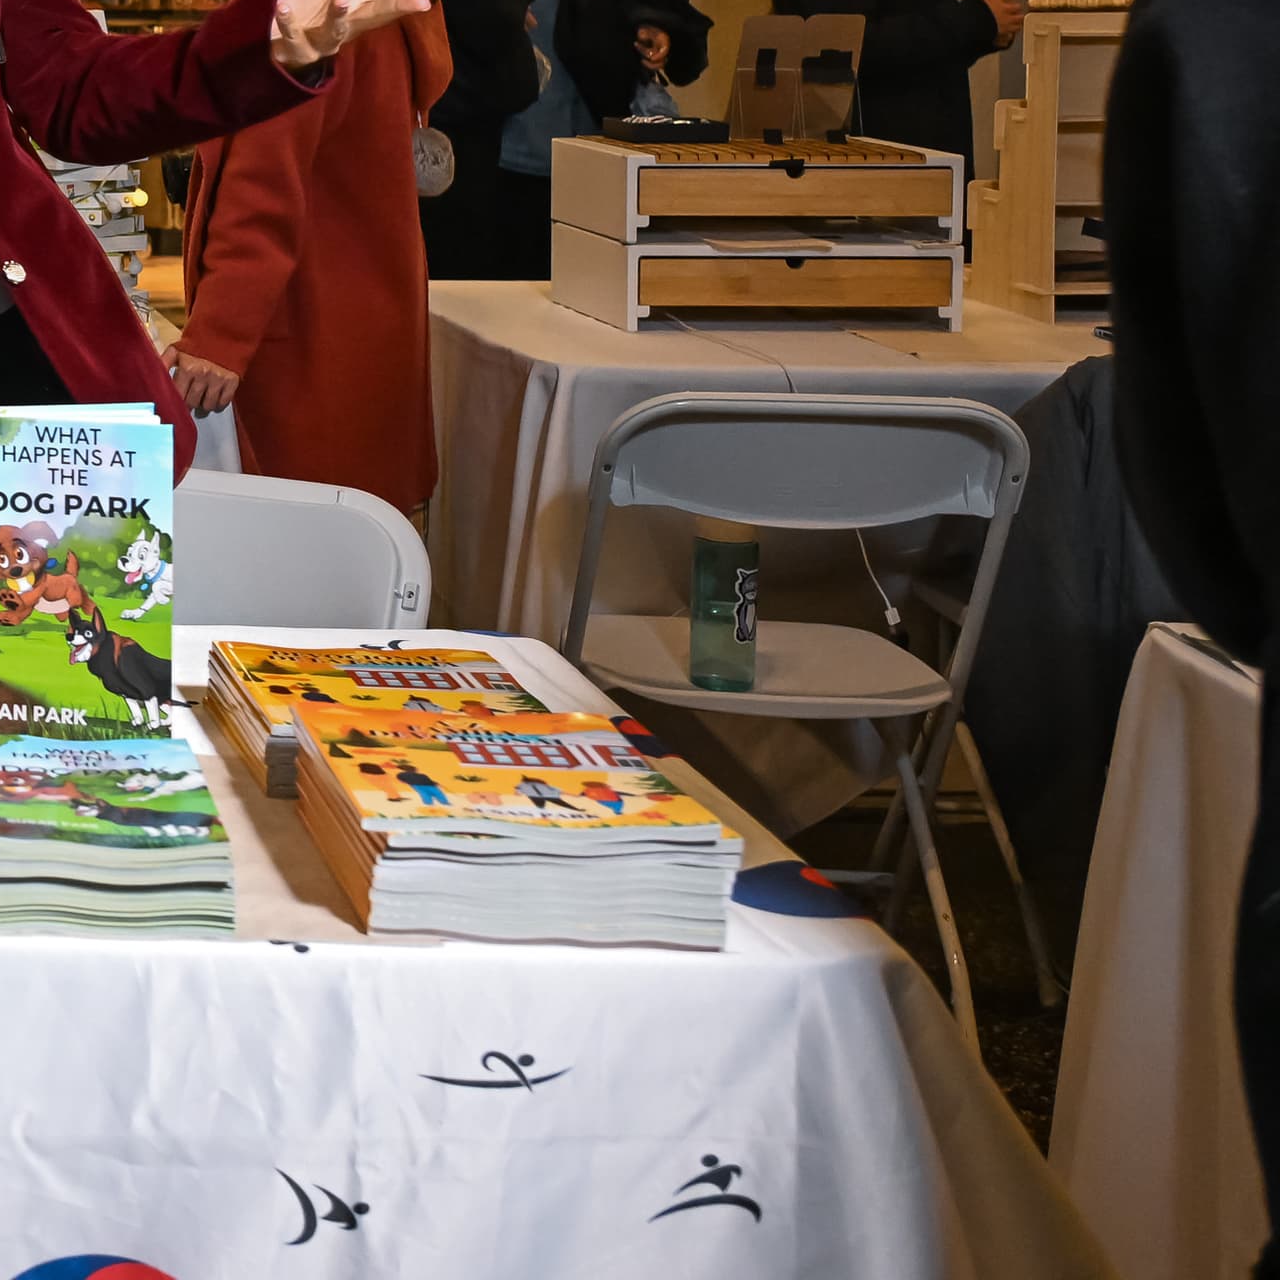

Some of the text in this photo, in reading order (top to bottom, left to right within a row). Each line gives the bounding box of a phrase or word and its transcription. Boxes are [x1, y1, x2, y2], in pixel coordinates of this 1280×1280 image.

[35, 426, 101, 445] WHAT
[2, 445, 137, 468] HAPPENS AT
[47, 468, 88, 486] THE
[64, 494, 152, 520] PARK
[33, 705, 88, 725] PARK
